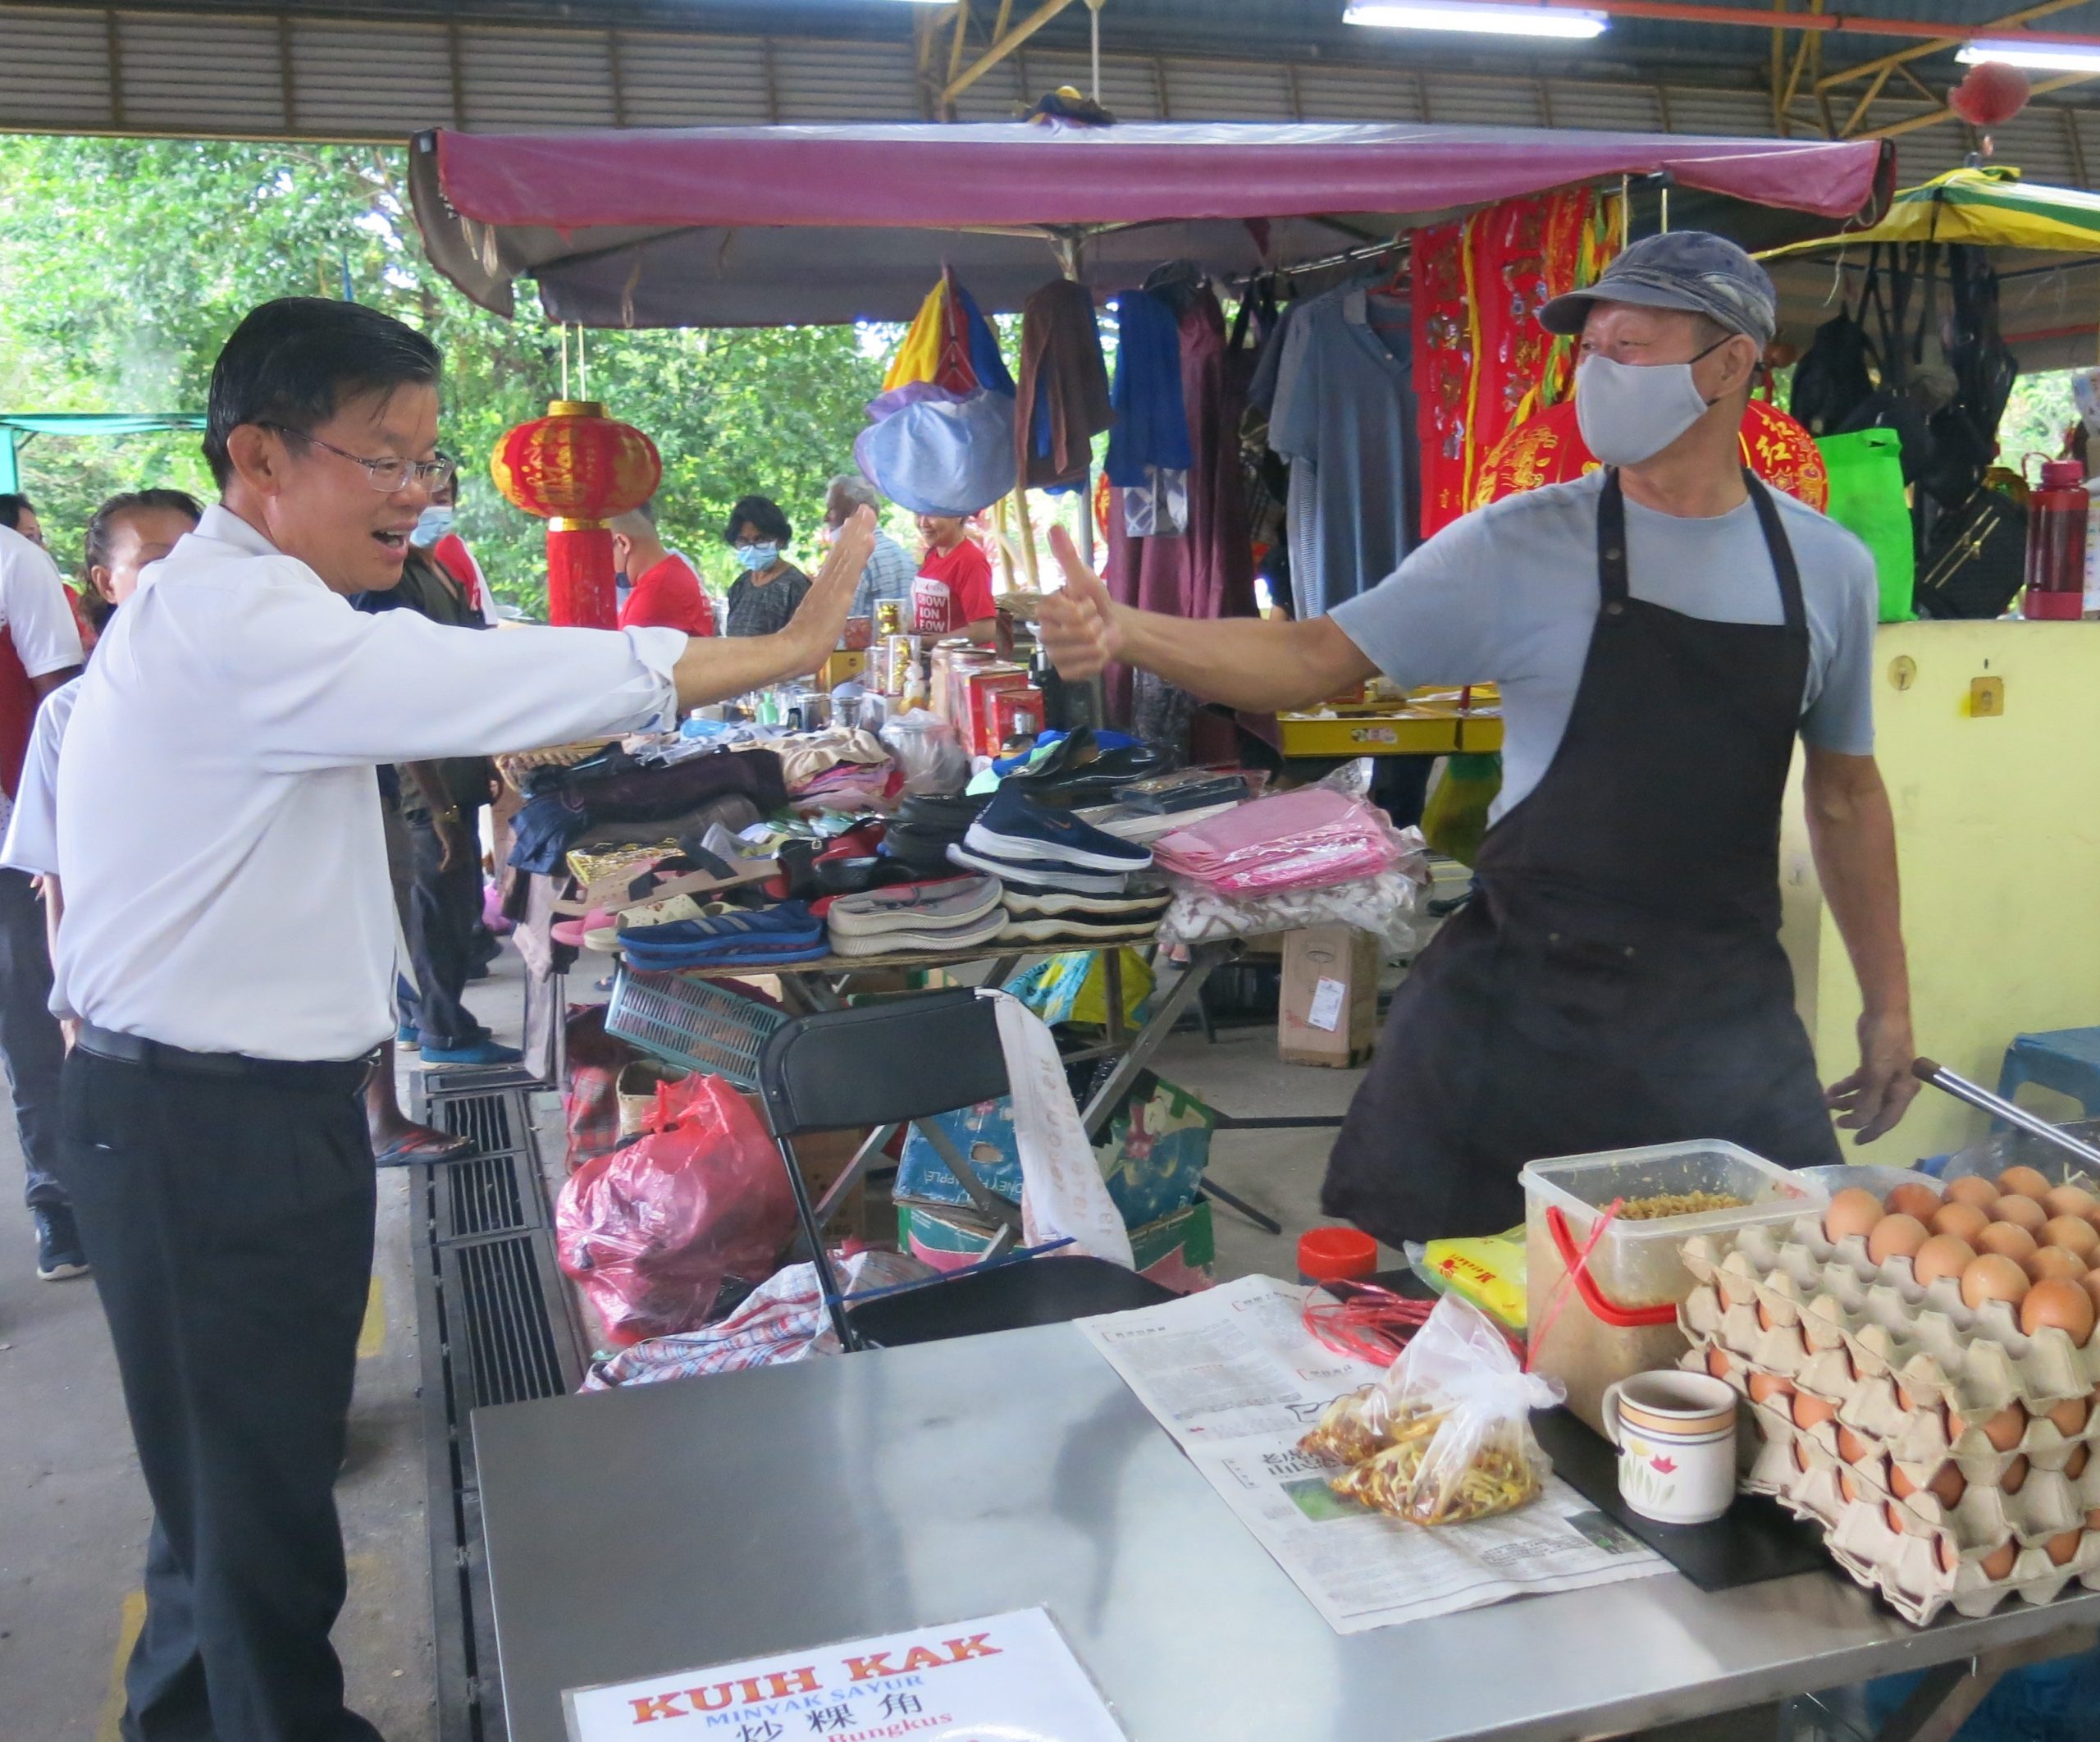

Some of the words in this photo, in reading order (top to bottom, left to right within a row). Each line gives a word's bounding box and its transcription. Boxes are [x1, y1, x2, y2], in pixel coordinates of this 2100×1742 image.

[628, 1666, 823, 1725] KUIH
[842, 1633, 1003, 1681] KAK
[705, 1694, 828, 1728] MINYAK
[830, 1675, 924, 1703] SAYUR
[827, 1712, 953, 1742] Bungkus
